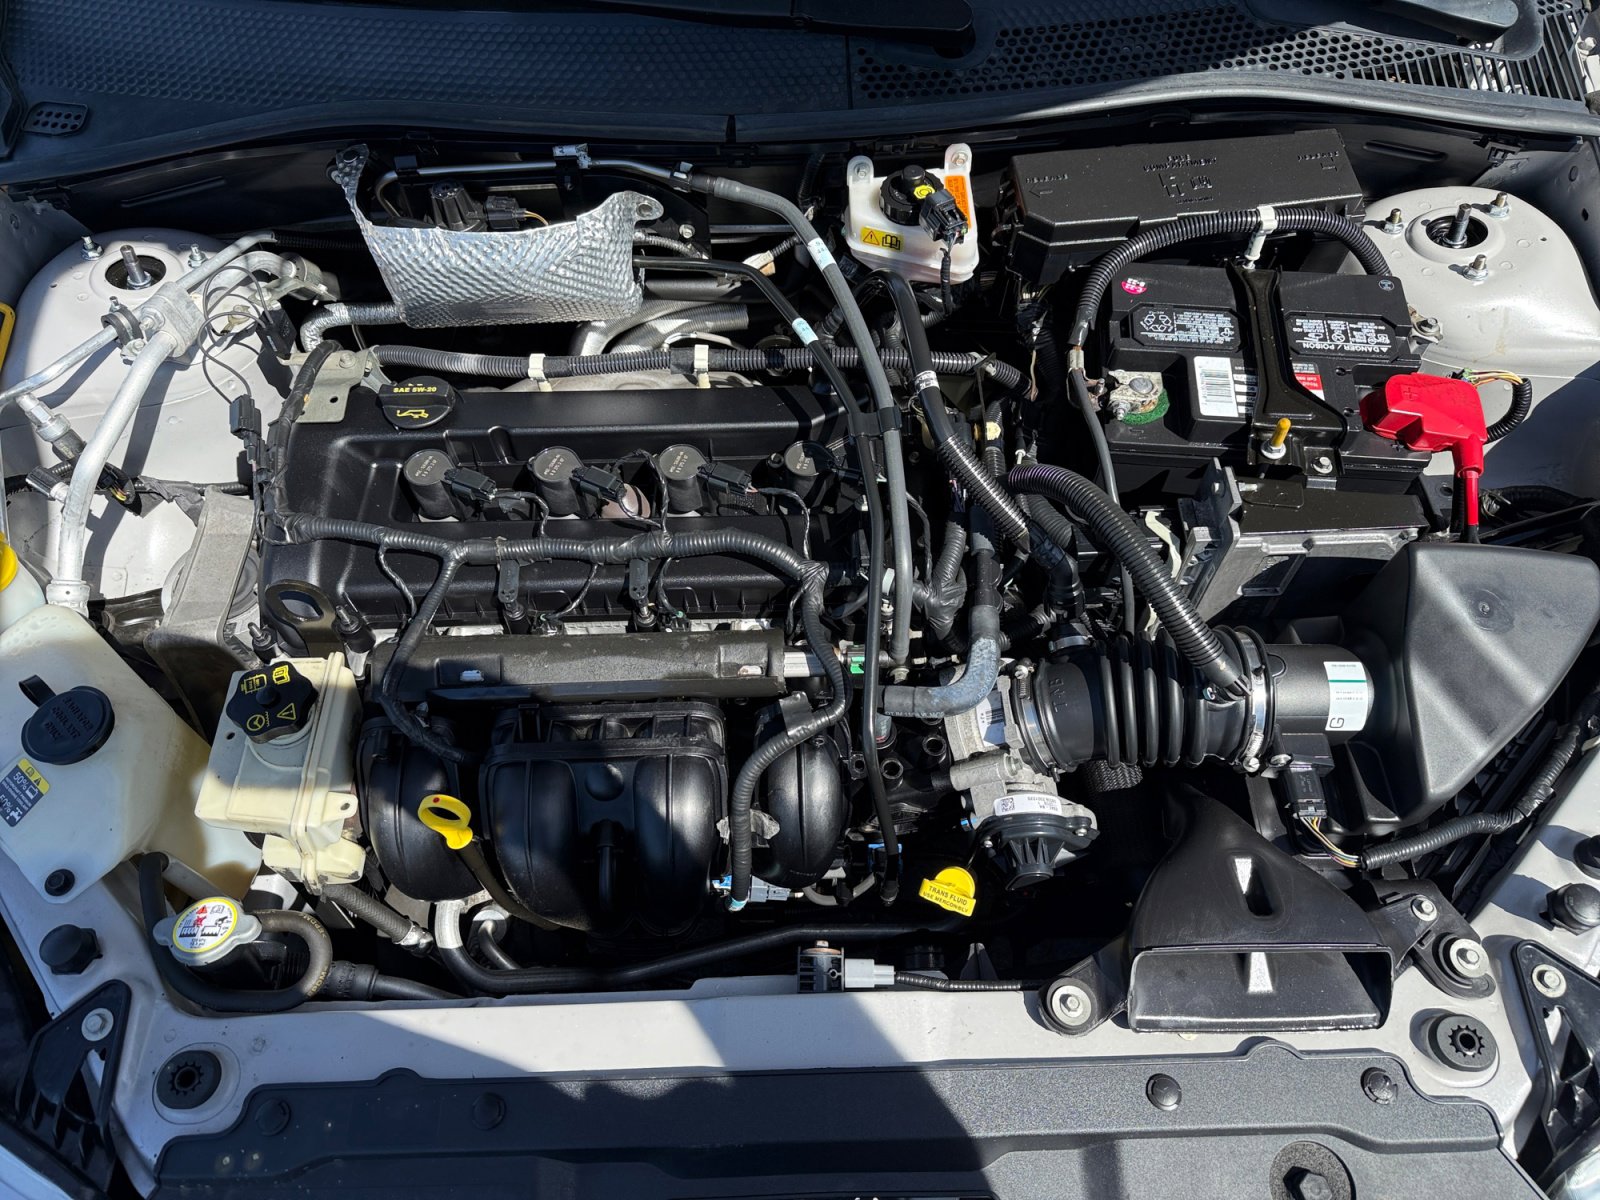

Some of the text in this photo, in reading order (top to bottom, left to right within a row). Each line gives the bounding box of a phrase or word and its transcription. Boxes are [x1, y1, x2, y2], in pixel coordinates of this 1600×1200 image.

[1302, 341, 1335, 350] POISON
[1343, 344, 1380, 353] DANGER
[13, 771, 29, 791] 50%
[929, 885, 968, 906] TRANS FLUID
